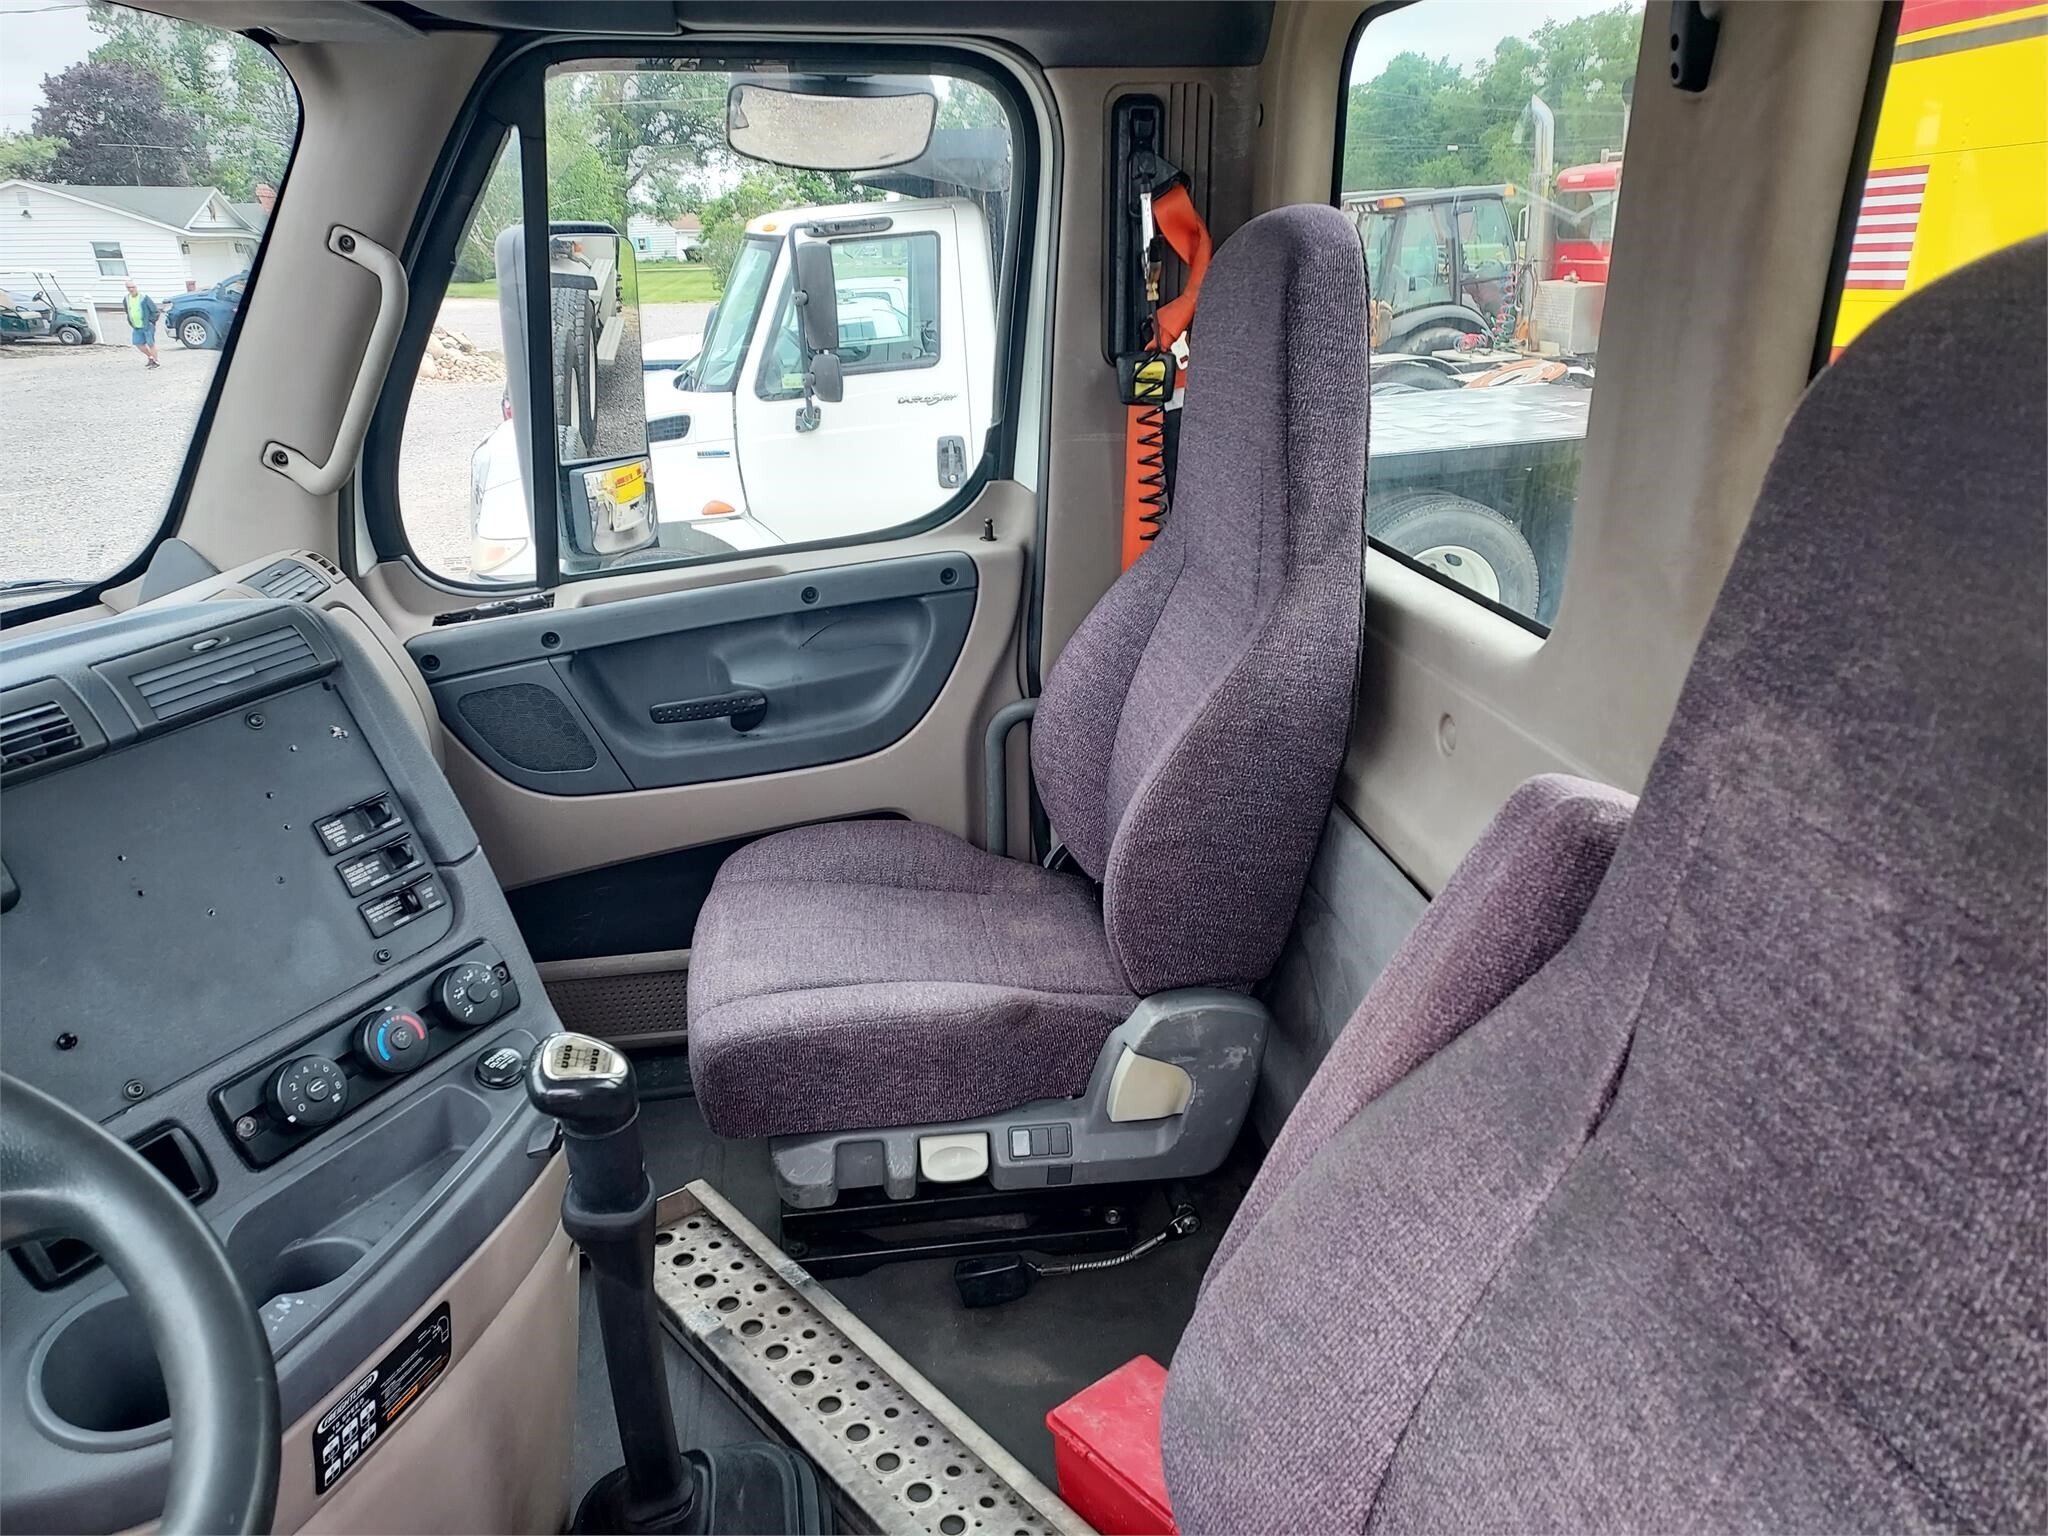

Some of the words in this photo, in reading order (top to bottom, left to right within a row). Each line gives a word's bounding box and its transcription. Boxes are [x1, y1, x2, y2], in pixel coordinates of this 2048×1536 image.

[323, 1064, 329, 1073] 6
[289, 1082, 298, 1092] 2
[334, 1080, 342, 1090] 8
[323, 1375, 374, 1427] FREIGHTLINER
[341, 1397, 365, 1422] SPEED
